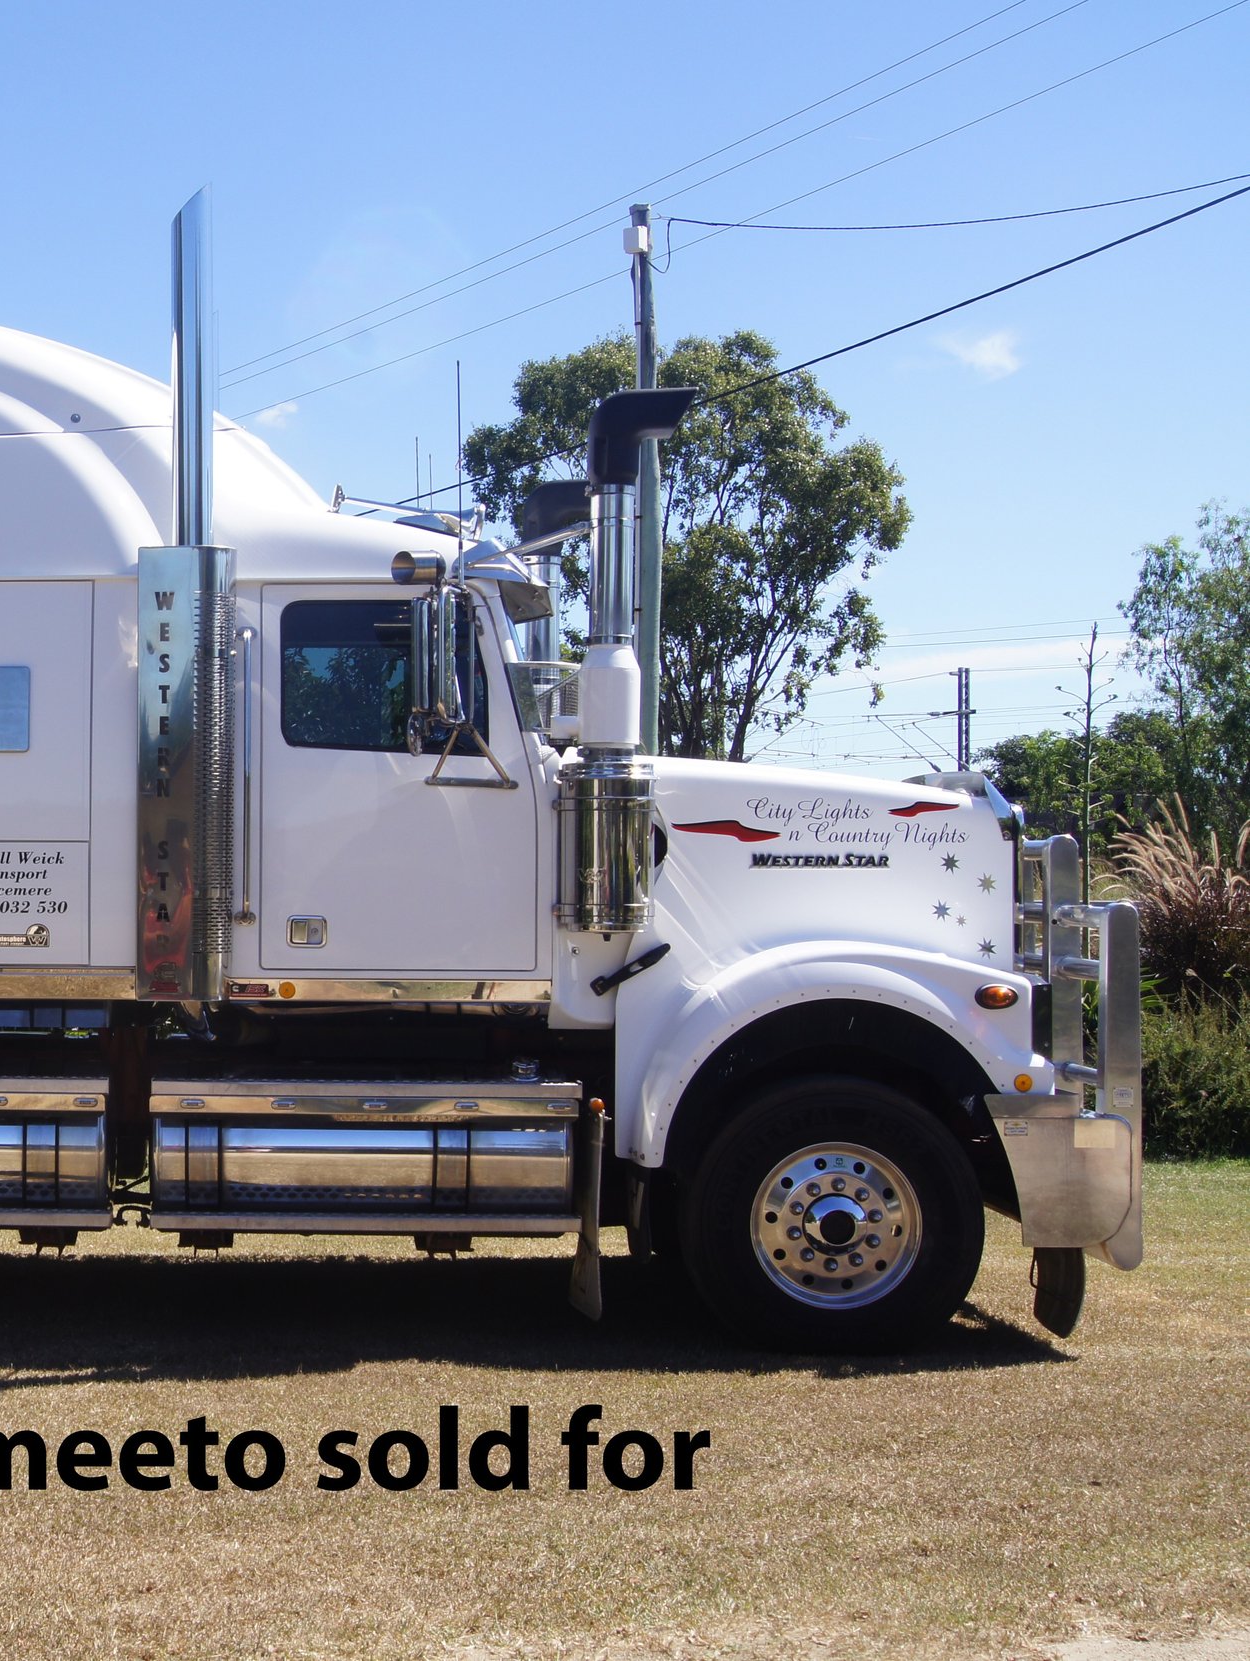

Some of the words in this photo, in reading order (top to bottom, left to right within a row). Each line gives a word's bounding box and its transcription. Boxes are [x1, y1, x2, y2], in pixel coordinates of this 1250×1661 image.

[155, 591, 175, 797] WESTERN
[746, 796, 796, 827] City
[798, 797, 874, 827] Lights
[807, 821, 893, 850] Country
[895, 822, 970, 850] Nights
[18, 851, 65, 865] Weick
[751, 853, 841, 868] WESTERN
[841, 853, 890, 868] STAR
[0, 901, 31, 914] 032
[36, 901, 68, 914] 530
